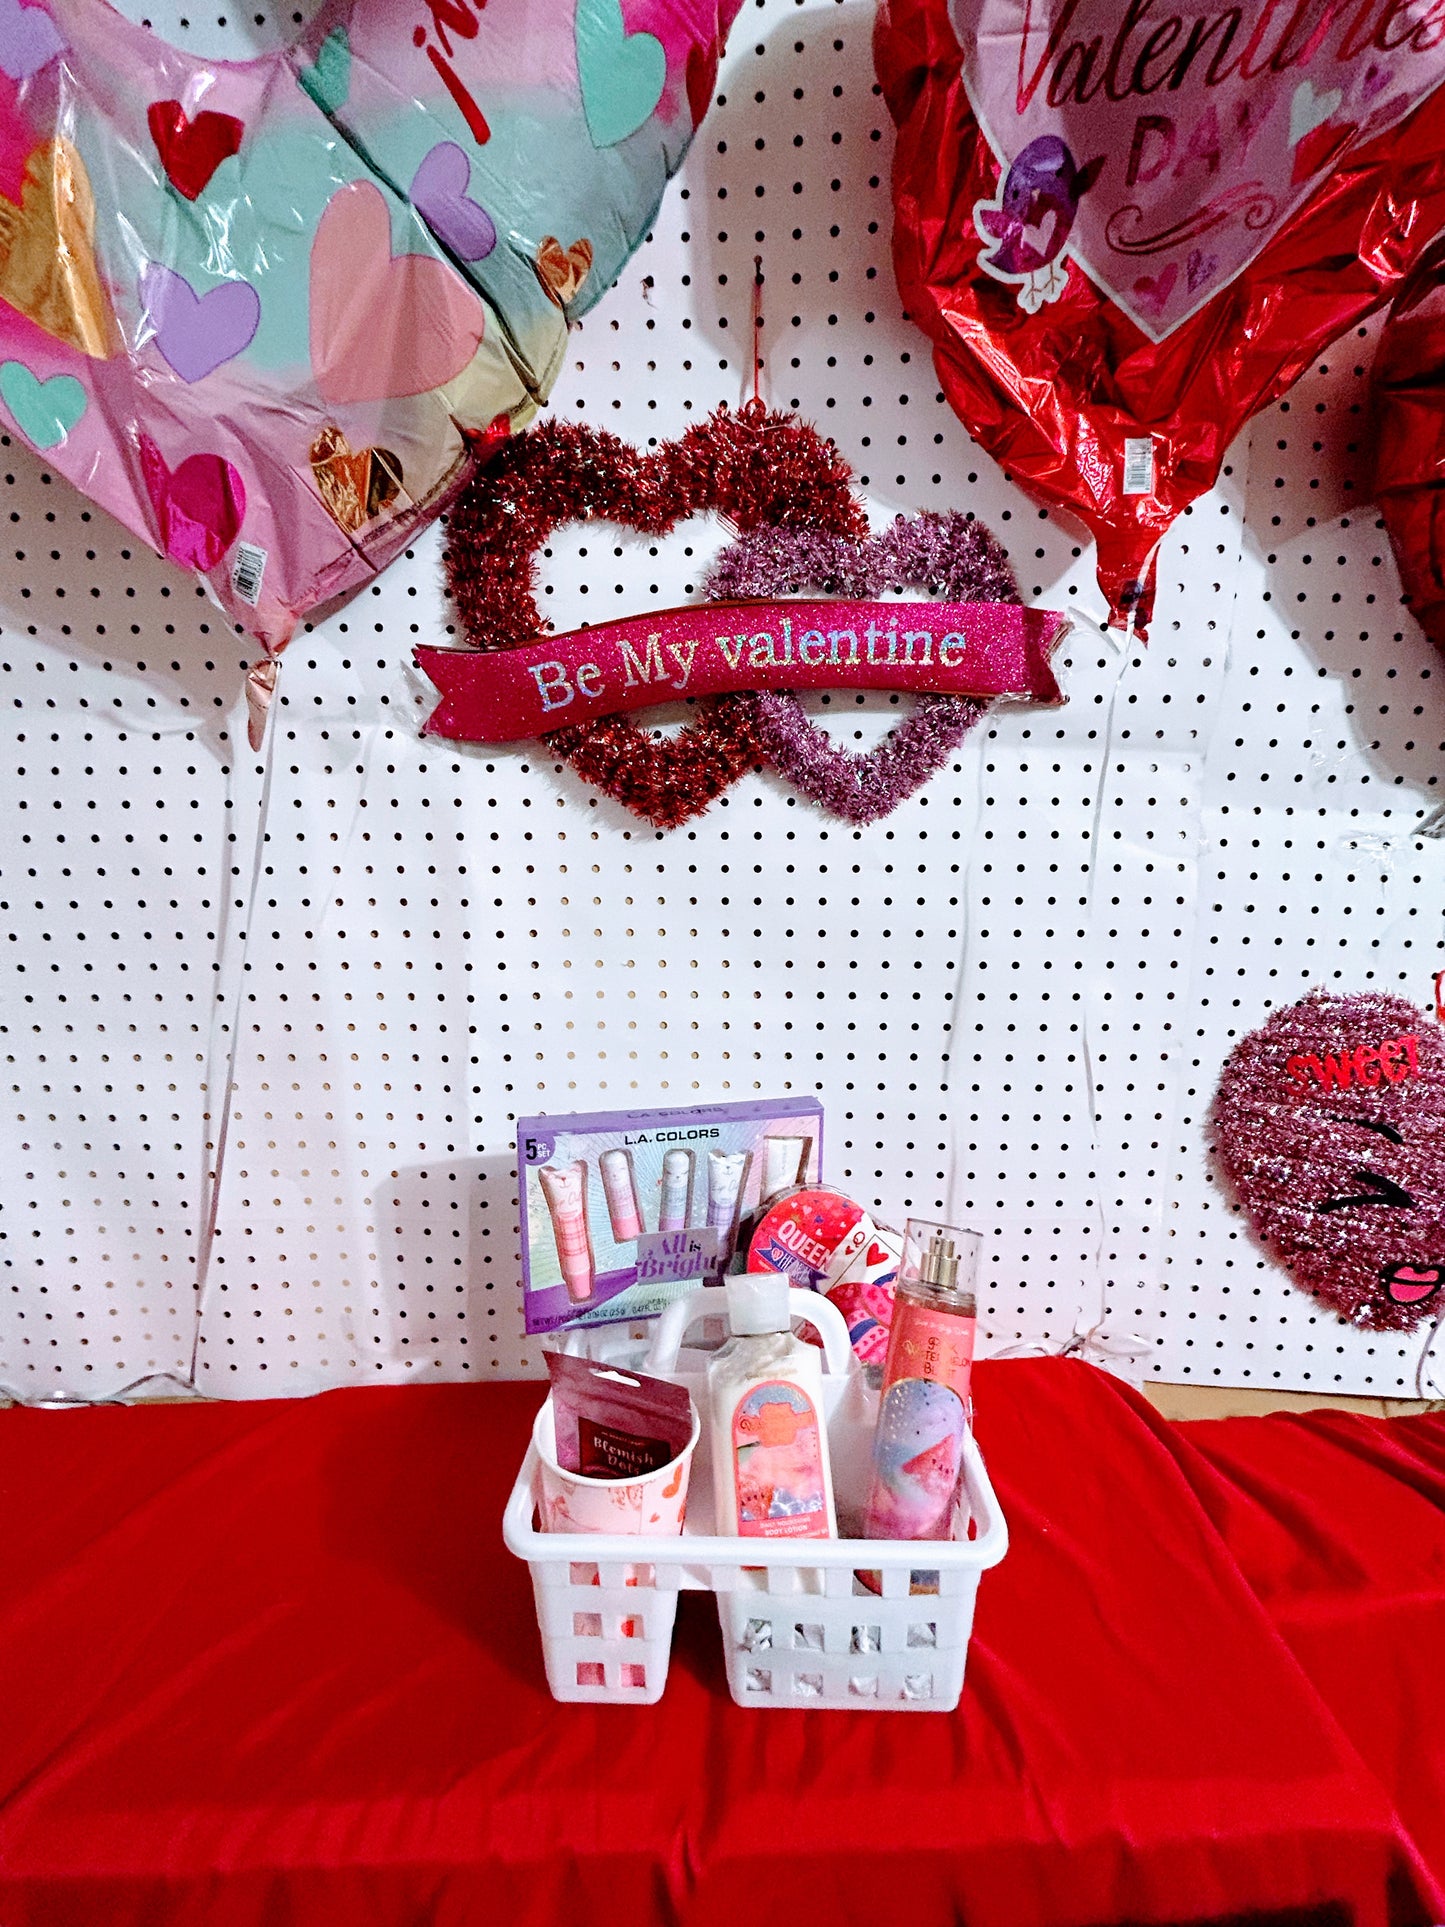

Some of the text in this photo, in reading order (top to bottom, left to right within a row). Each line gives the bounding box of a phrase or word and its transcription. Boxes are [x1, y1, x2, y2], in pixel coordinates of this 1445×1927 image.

[1126, 99, 1273, 188] DAY
[528, 617, 967, 713] Be My valentine
[624, 1128, 720, 1146] L.A. COLORS
[525, 1138, 537, 1161] 5
[537, 1150, 551, 1158] SET
[653, 1233, 702, 1256] All is
[853, 1231, 866, 1248] Q
[593, 1436, 654, 1465] Blemish
[607, 1454, 640, 1475] Dots
[784, 1525, 808, 1534] LOTION
